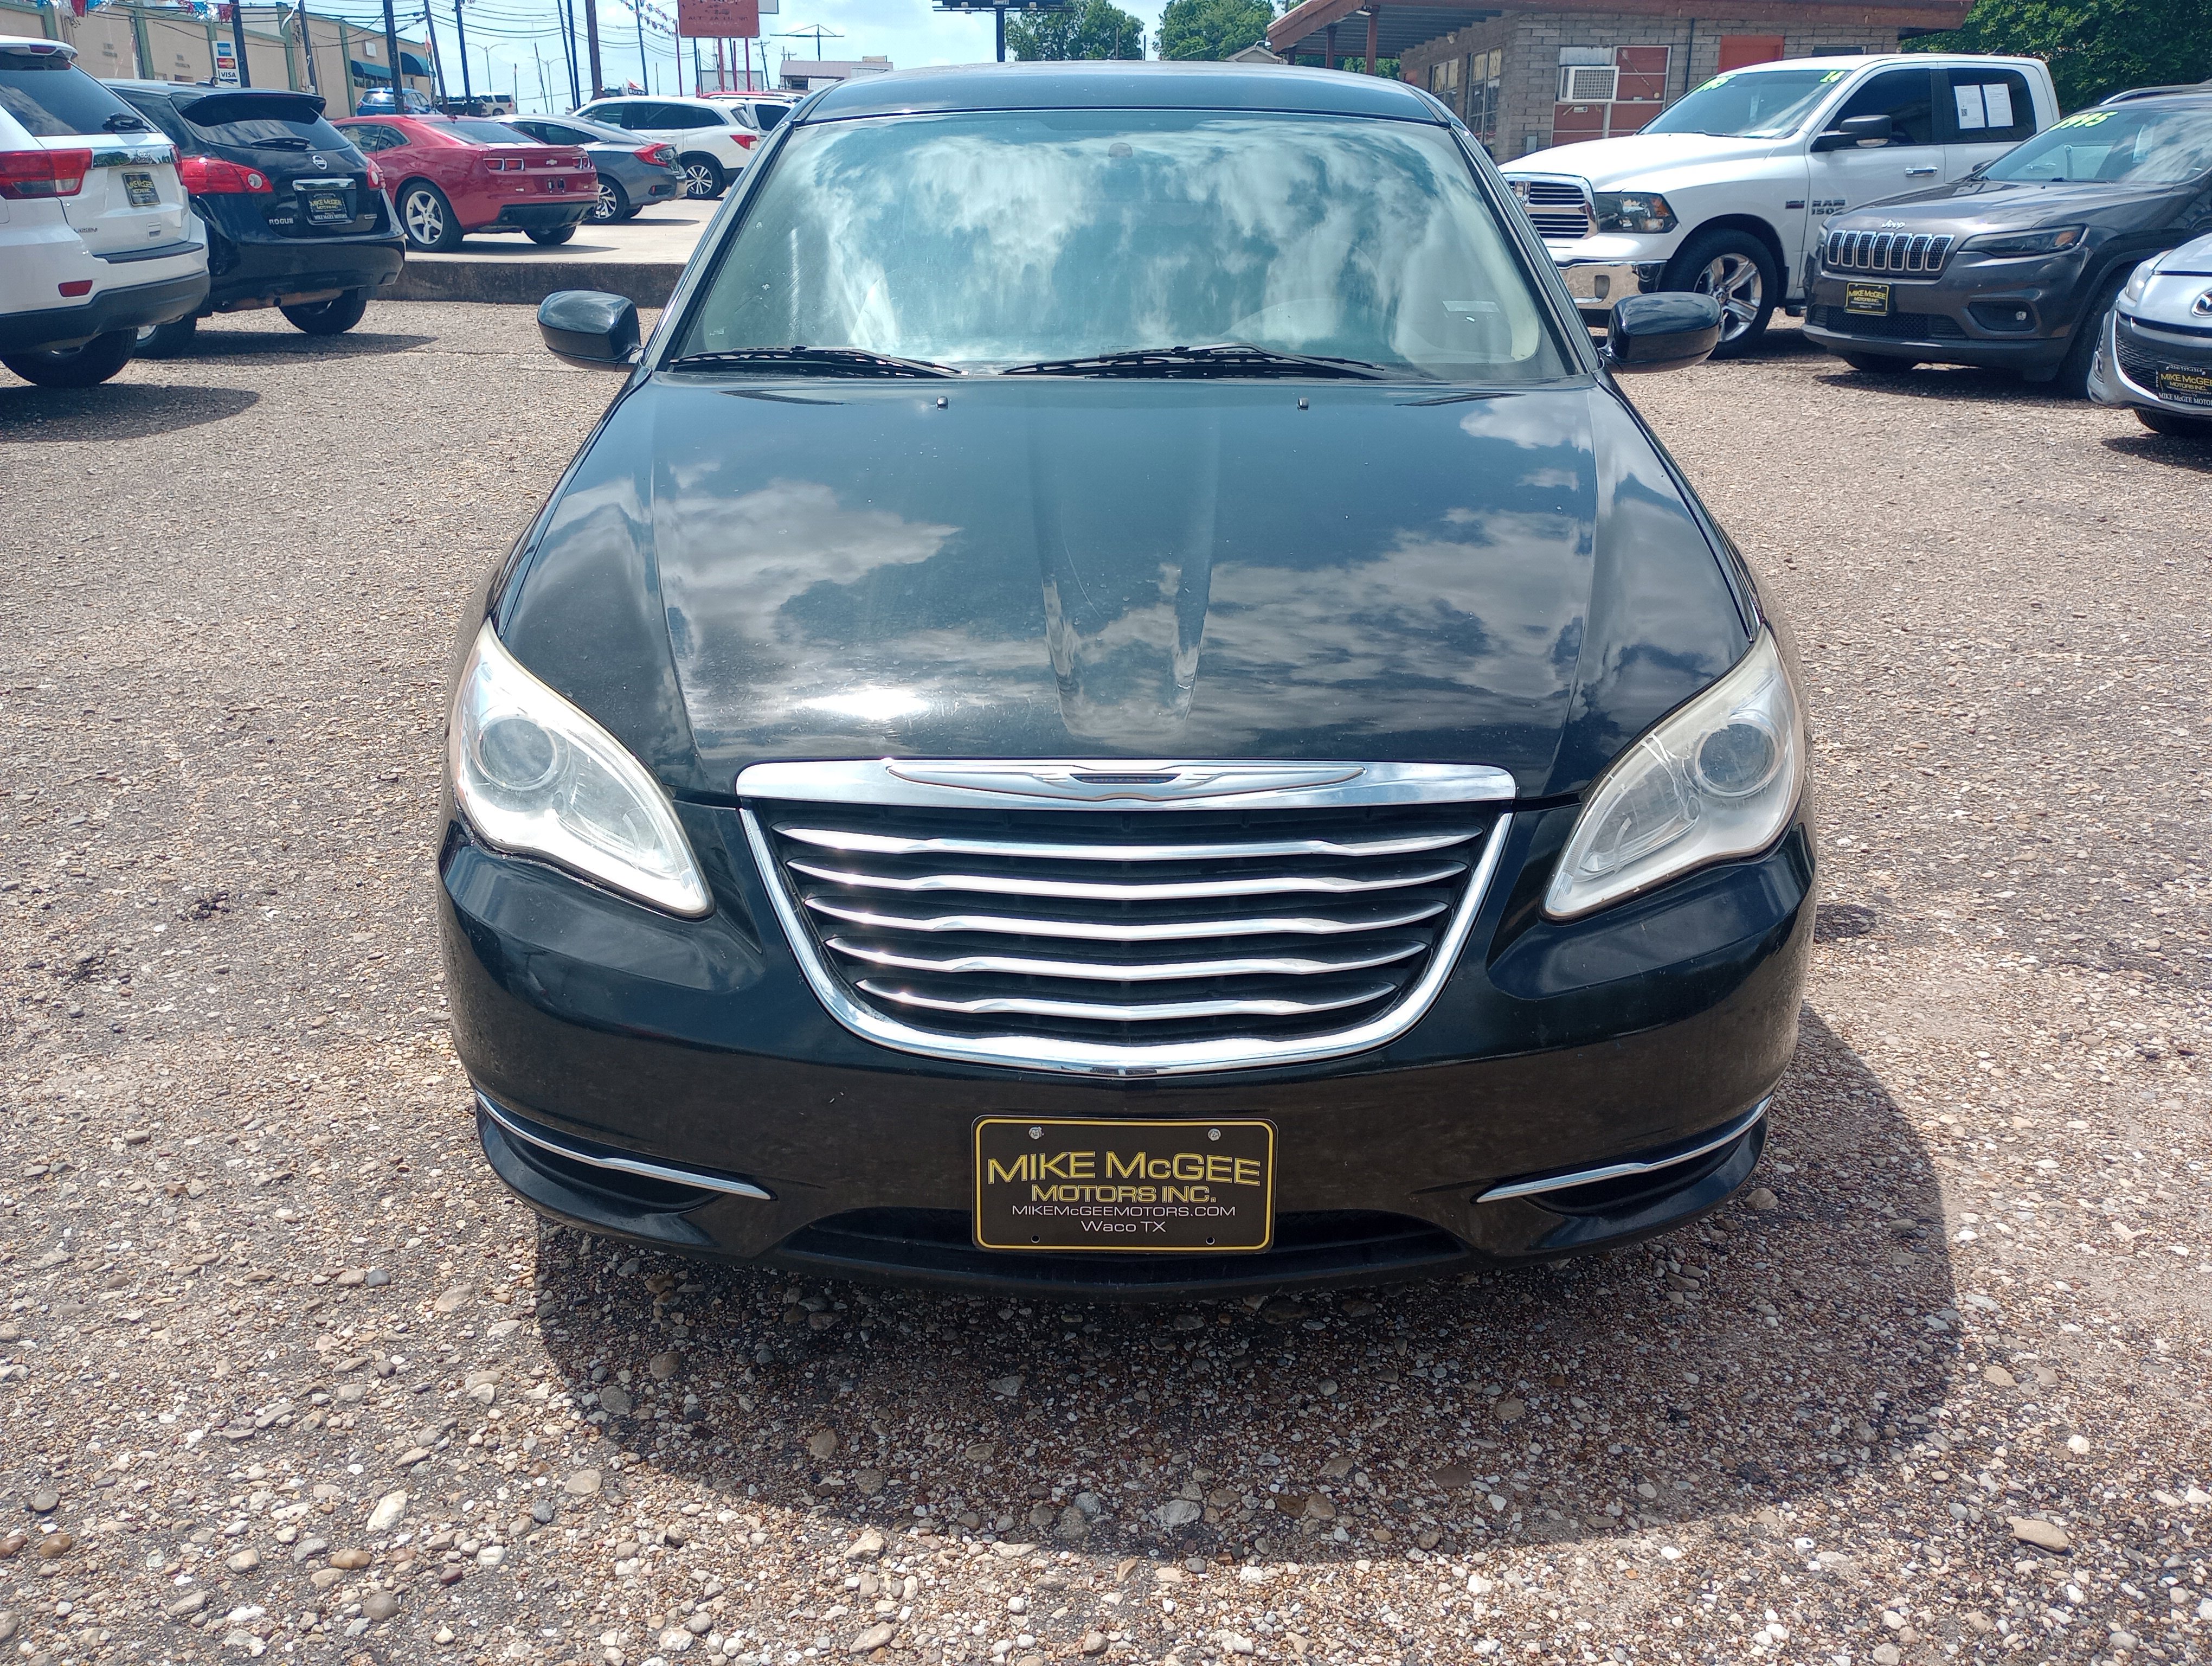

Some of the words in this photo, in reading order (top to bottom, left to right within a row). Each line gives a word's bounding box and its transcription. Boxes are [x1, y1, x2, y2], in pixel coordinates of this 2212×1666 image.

[1819, 71, 1846, 83] 14
[1881, 219, 1906, 230] Jeep
[1865, 290, 1886, 299] McGEE
[2160, 373, 2181, 382] MIKE
[2158, 392, 2174, 400] MIKE
[2174, 395, 2193, 403] McGEE
[988, 1151, 1096, 1185] MIKE
[1105, 1151, 1261, 1187] McGEE
[1031, 1184, 1157, 1203] MOTORS
[1162, 1186, 1216, 1203] INC.
[1012, 1205, 1236, 1217] MIKEMcGEEMOTORS.COM
[1081, 1220, 1137, 1233] Waco
[1140, 1221, 1166, 1233] TX
